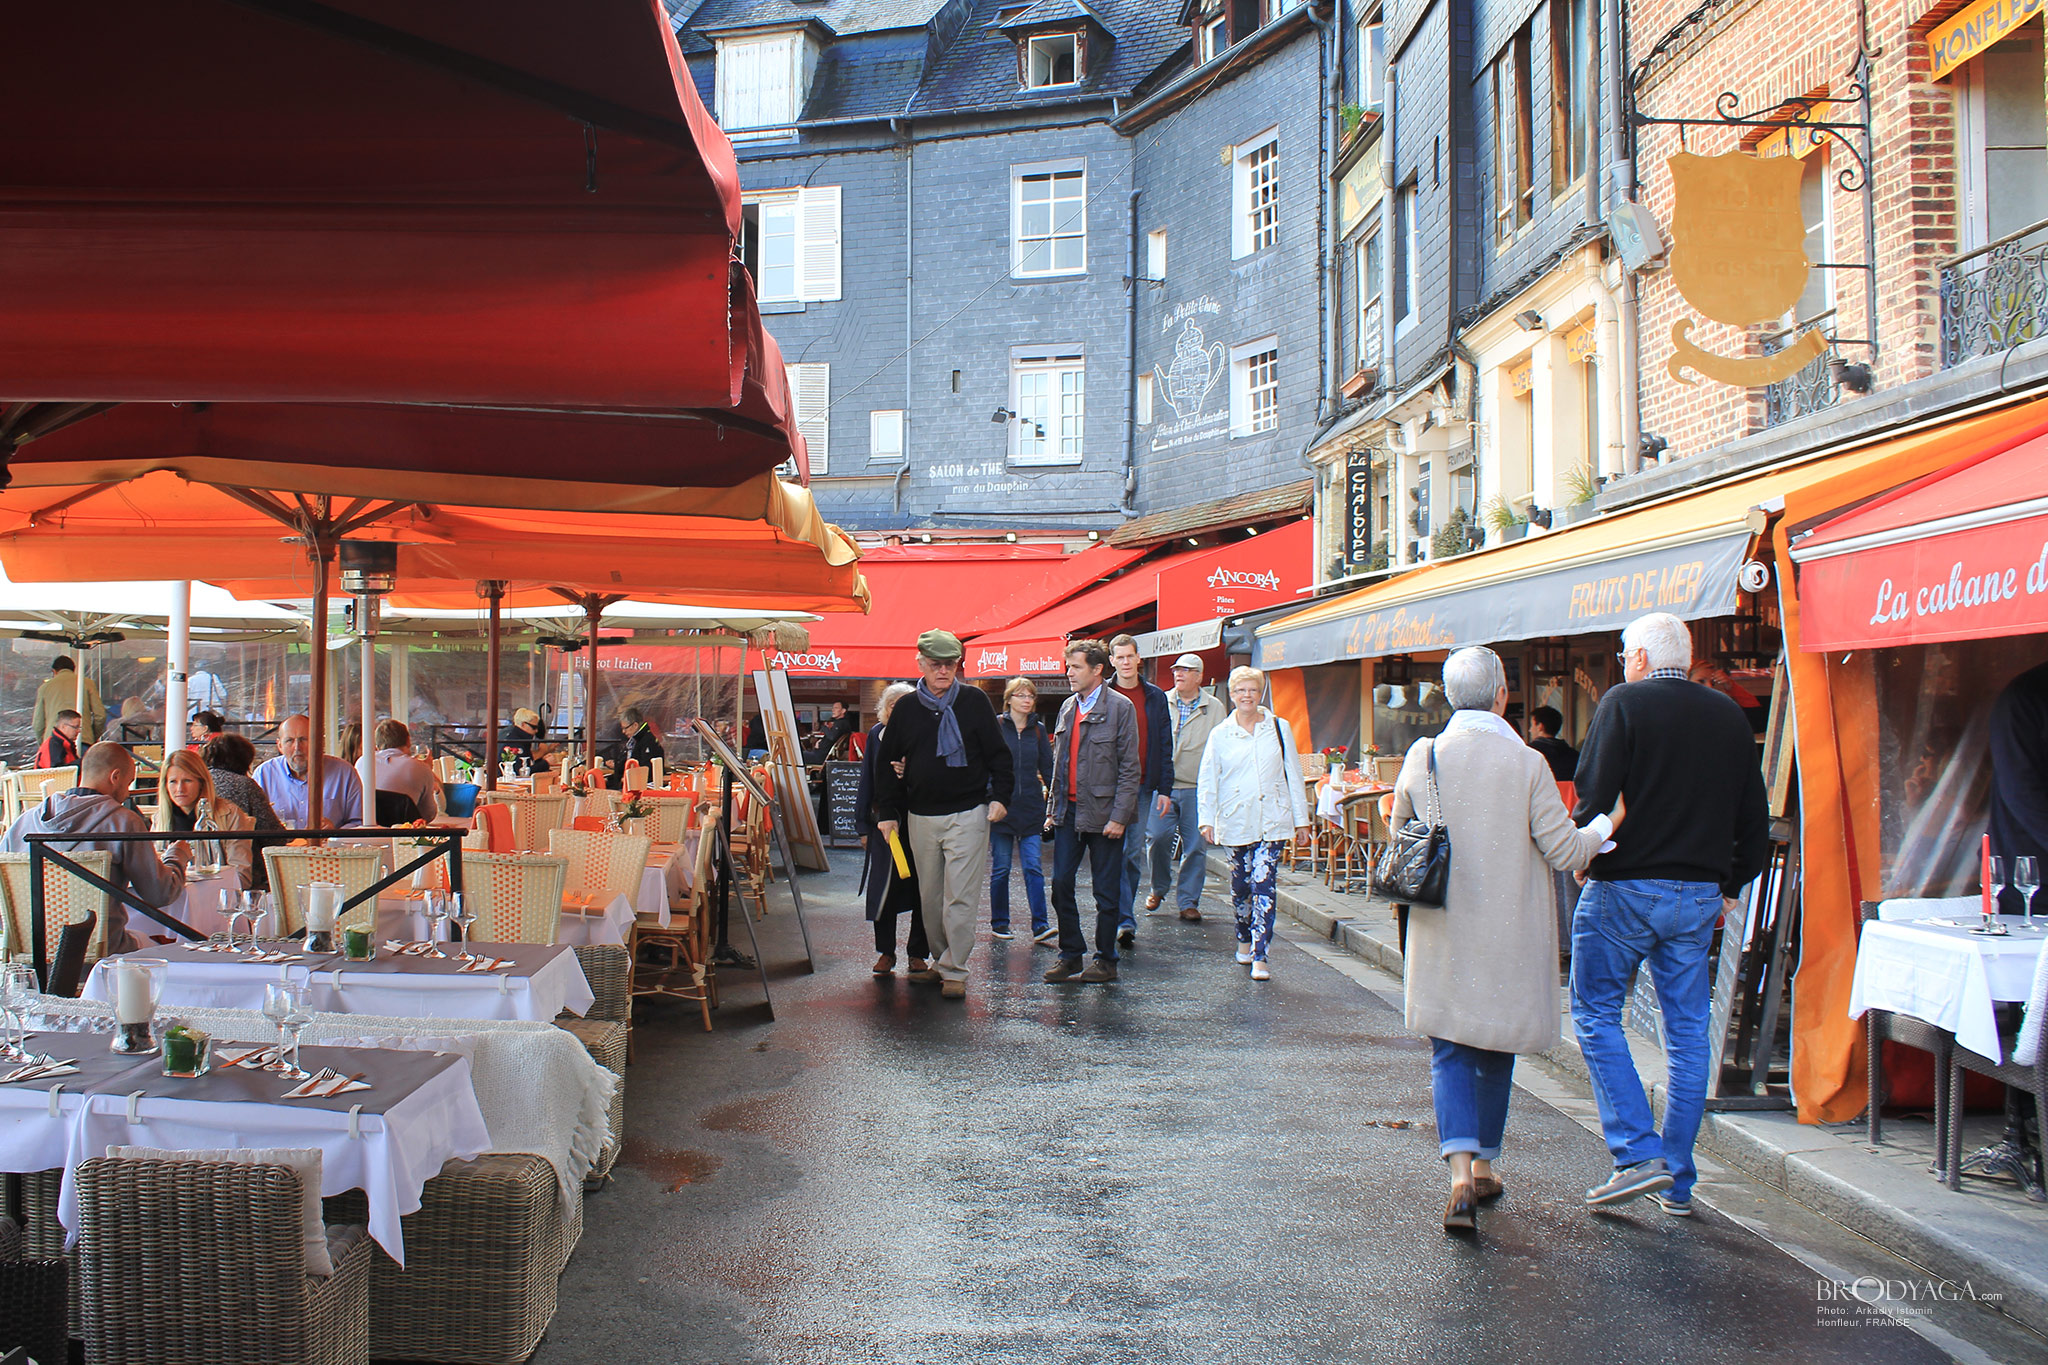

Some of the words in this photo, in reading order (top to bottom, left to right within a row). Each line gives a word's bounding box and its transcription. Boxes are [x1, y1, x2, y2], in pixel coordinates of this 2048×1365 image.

[1174, 303, 1198, 323] Petite
[929, 464, 963, 478] SALON
[967, 466, 979, 476] de
[981, 462, 1003, 476] THE
[1348, 453, 1367, 468] La
[952, 485, 969, 494] rue
[973, 483, 985, 493] du
[987, 481, 1029, 495] Dauphin
[1351, 471, 1367, 562] CHALOUPE
[1207, 566, 1280, 591] ANCORA
[1568, 575, 1629, 619] FRUITS
[1629, 569, 1658, 611] DE
[1657, 561, 1704, 606] MER
[1869, 578, 1909, 625] La
[1916, 561, 2018, 616] cabane
[1217, 606, 1235, 614] Pizza
[1346, 617, 1361, 654] Le
[1391, 607, 1435, 649] Bistrot
[614, 657, 653, 670] Italien
[771, 649, 842, 672] ANCORA
[977, 646, 1009, 673] ANCORA
[1020, 657, 1039, 671] Bistrot
[1040, 656, 1060, 671] Italien
